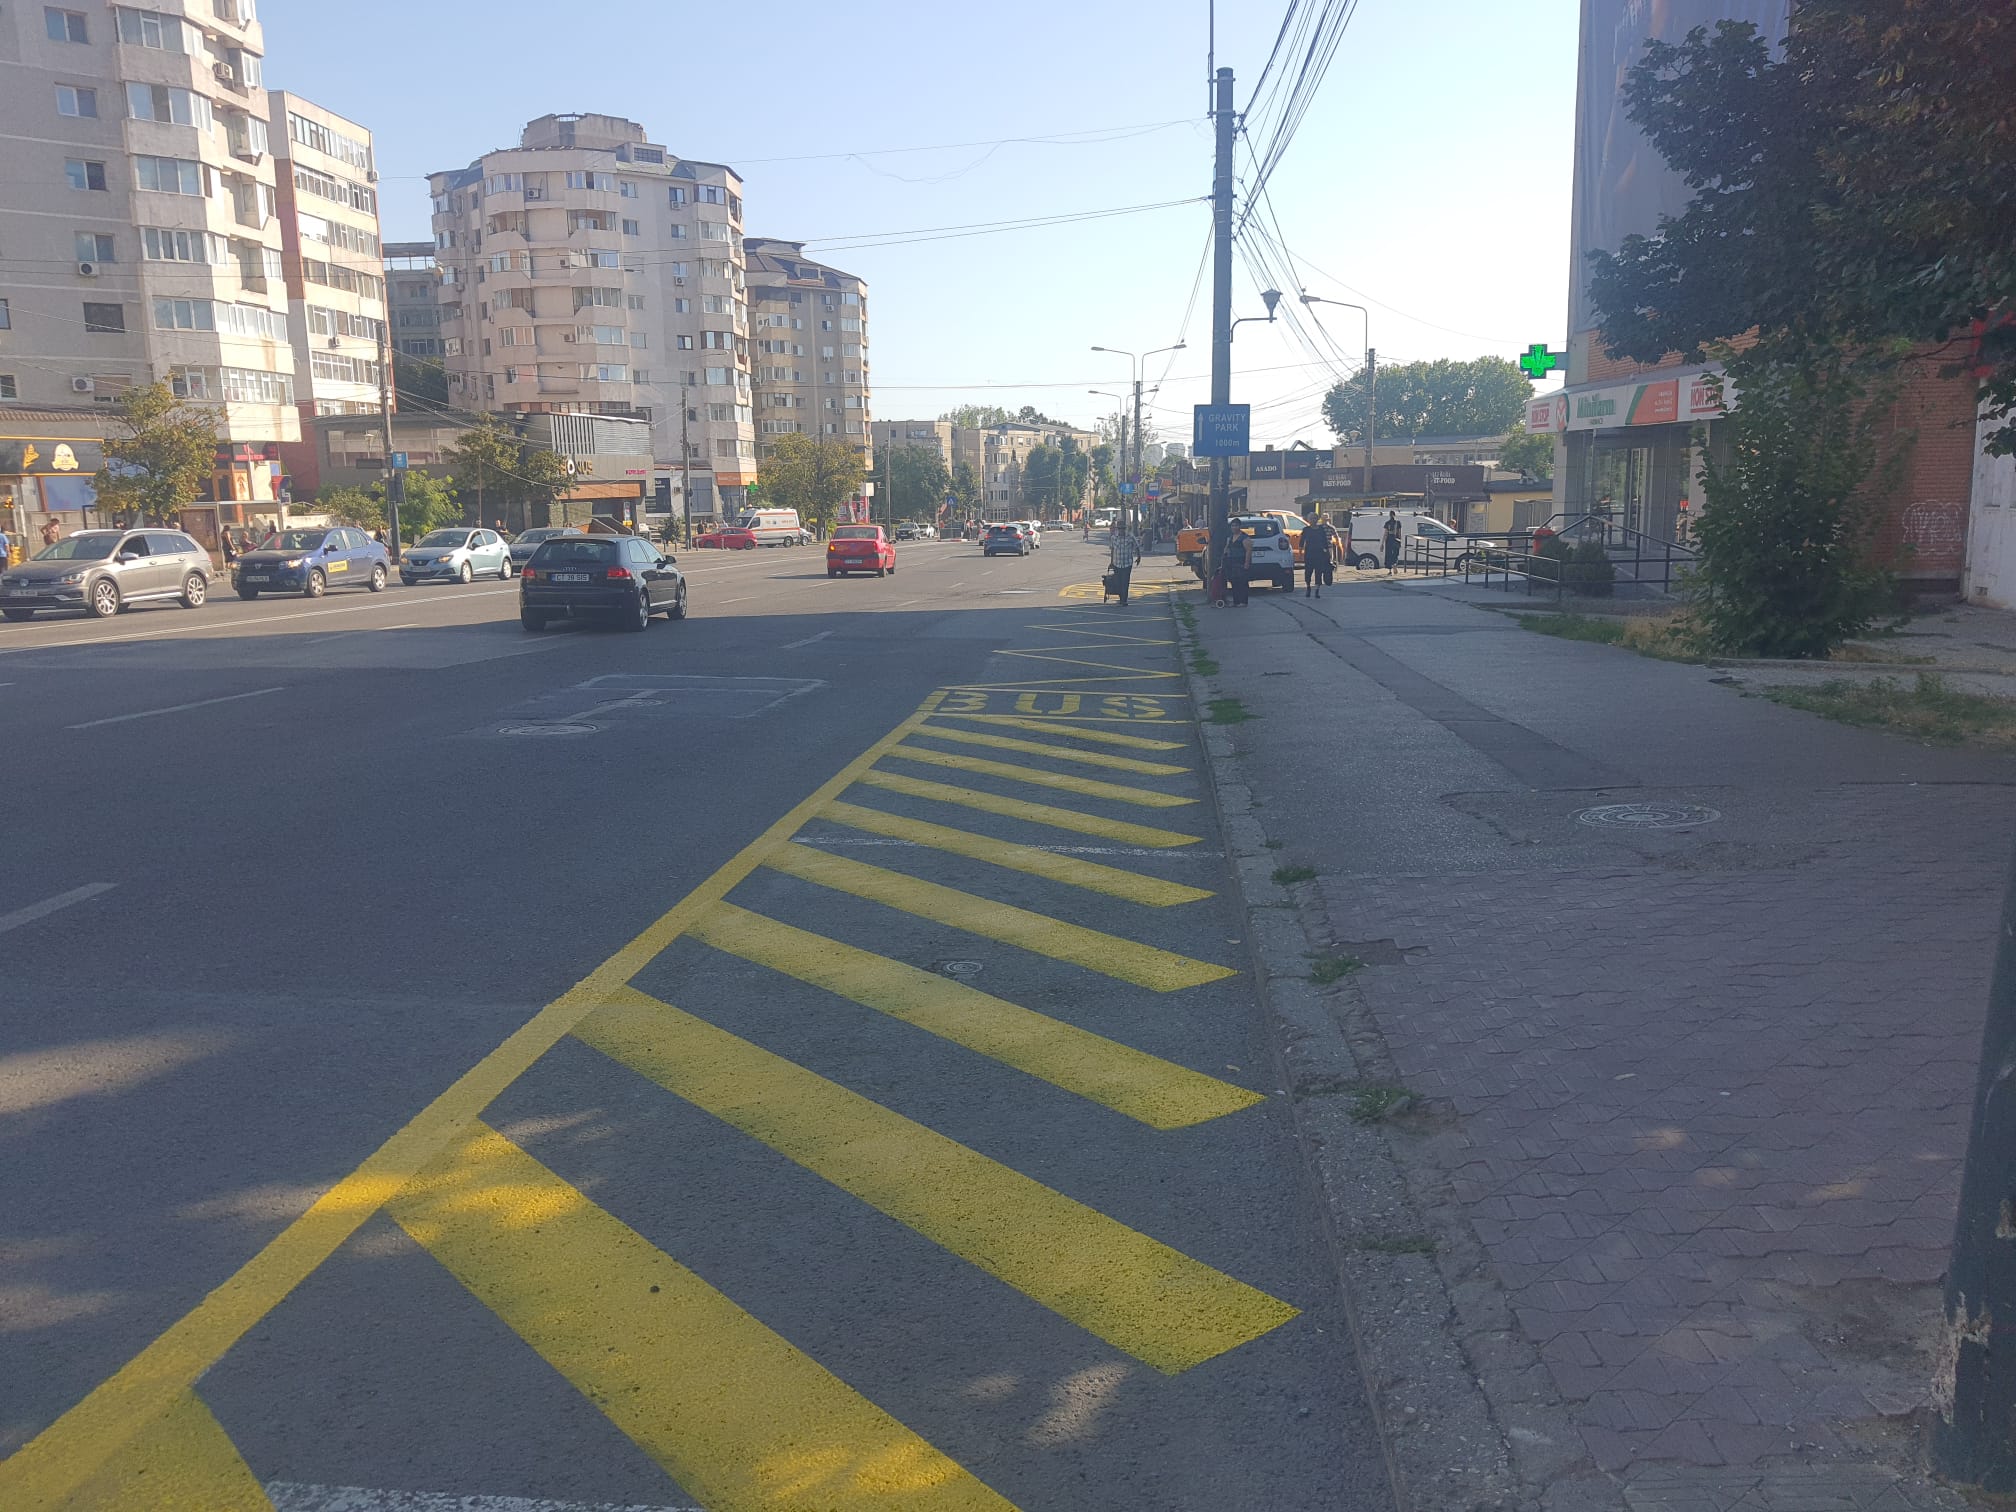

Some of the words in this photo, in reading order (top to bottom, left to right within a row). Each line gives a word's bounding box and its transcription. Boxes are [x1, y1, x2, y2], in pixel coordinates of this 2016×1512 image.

[1208, 413, 1246, 422] GRAVITY
[1215, 439, 1240, 447] 1000m
[917, 690, 1167, 718] BUS
